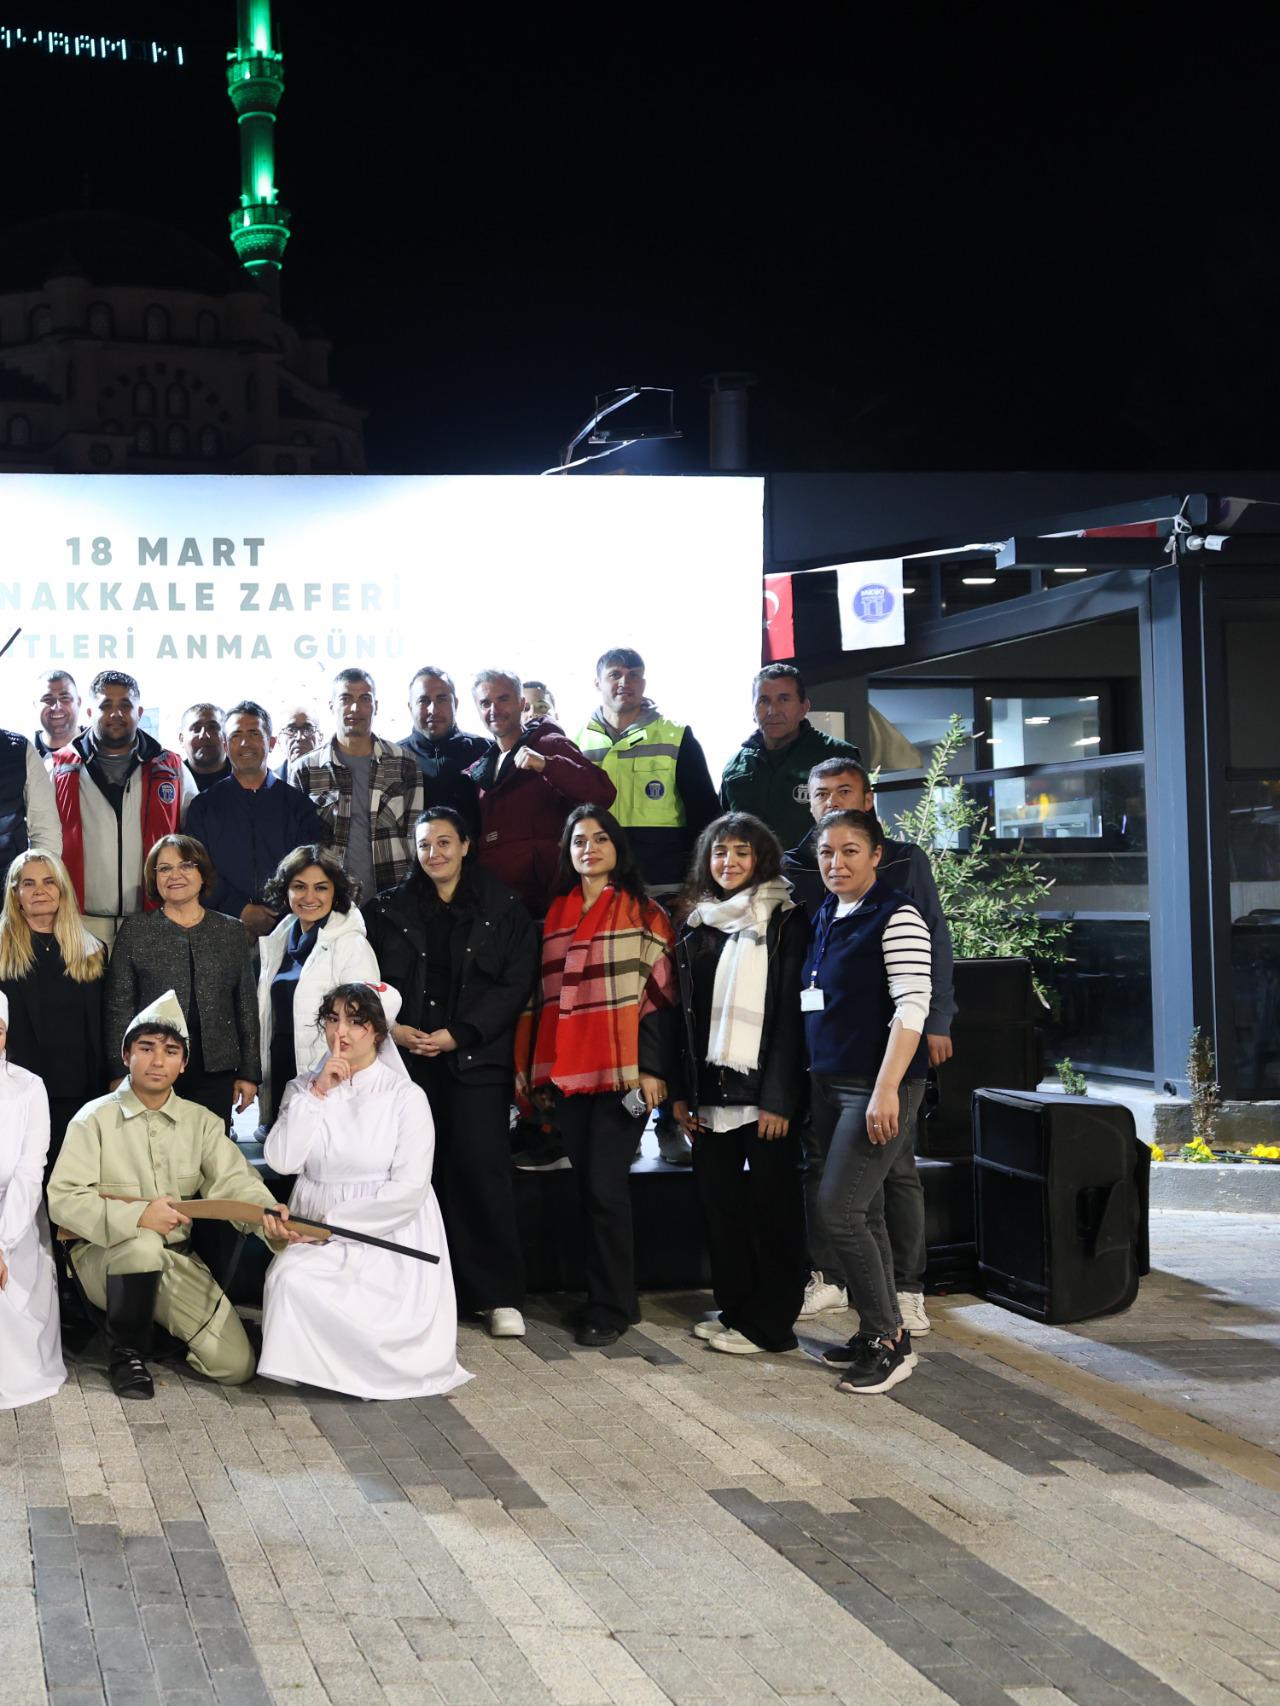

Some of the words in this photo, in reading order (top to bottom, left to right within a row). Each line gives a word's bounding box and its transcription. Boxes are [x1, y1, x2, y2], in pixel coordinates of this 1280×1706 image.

[65, 536, 113, 566] 18
[138, 536, 266, 567] MART
[156, 633, 273, 660] ANMA
[293, 627, 405, 660] GÜNÜ
